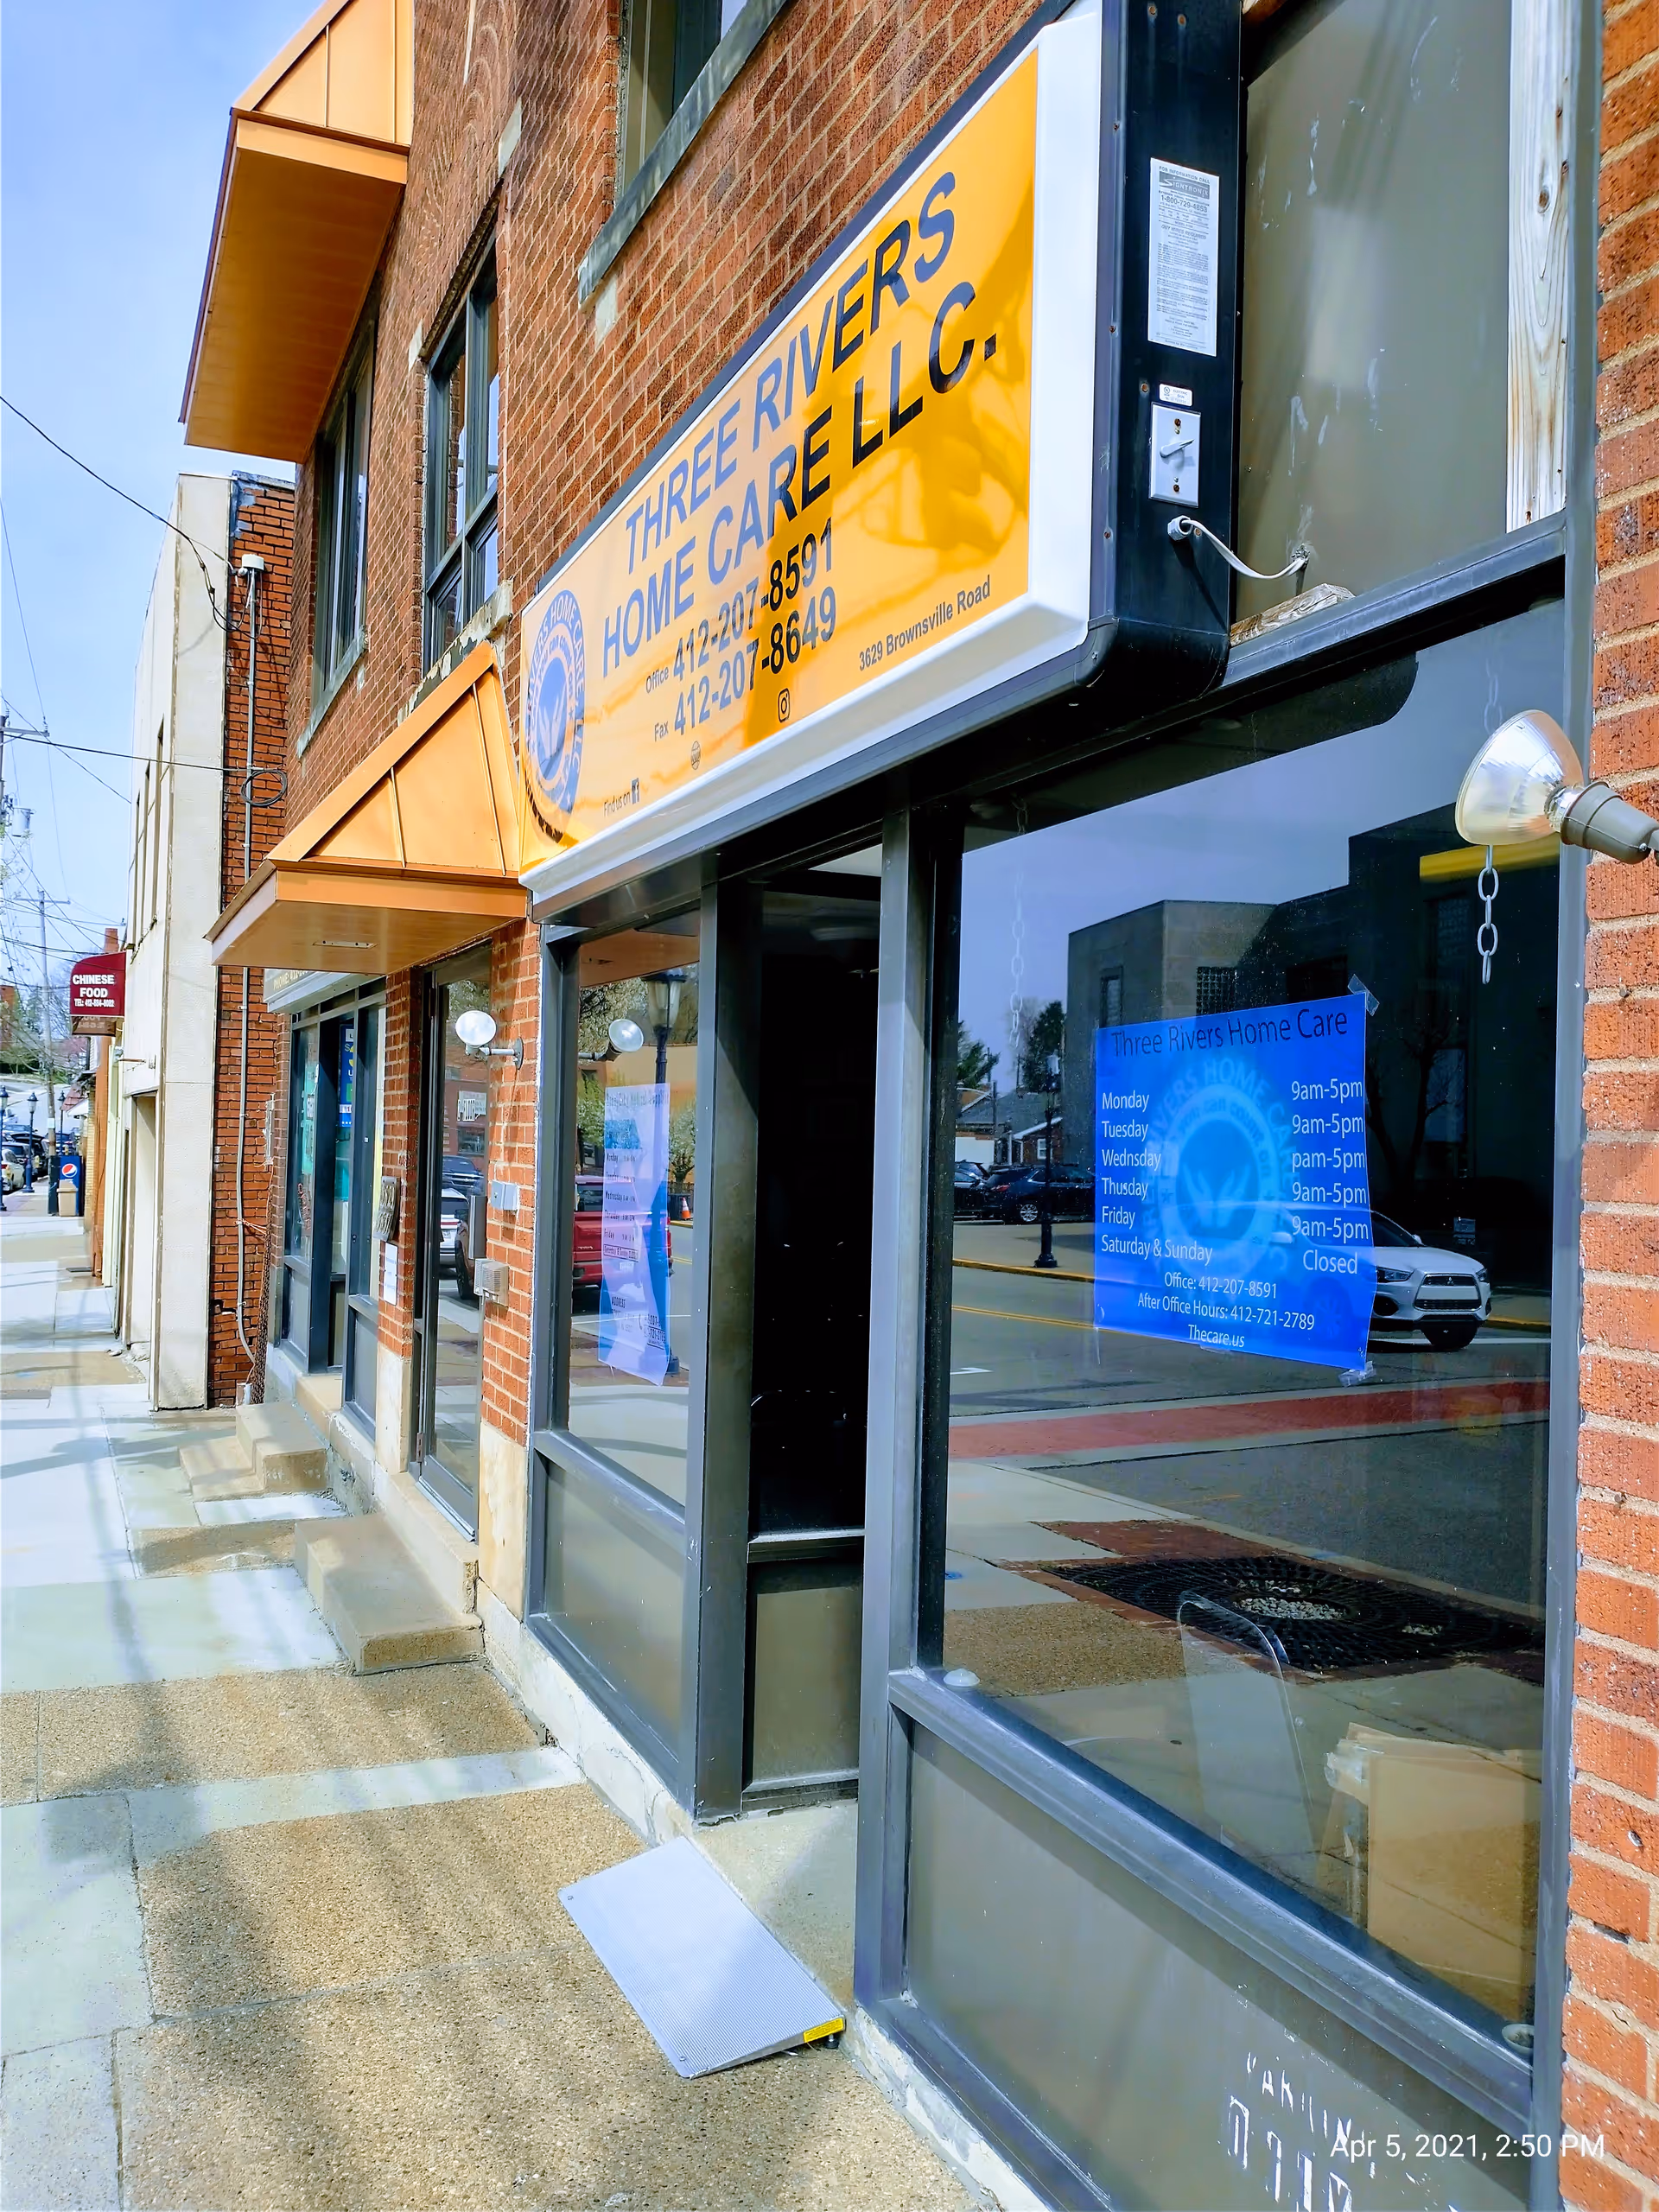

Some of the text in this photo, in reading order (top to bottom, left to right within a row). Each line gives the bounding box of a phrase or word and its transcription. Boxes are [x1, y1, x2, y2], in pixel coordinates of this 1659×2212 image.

[626, 171, 956, 575] THREE RIVERS
[603, 535, 696, 678] HOME
[709, 405, 832, 586] CARE
[852, 281, 996, 470] LLC.
[550, 594, 577, 630] HOME
[645, 517, 834, 694] Office 412-207-8591
[859, 574, 990, 671] 3629 Brownsville Road
[654, 586, 836, 742] Fax 412-207-8649
[73, 975, 115, 985] CHINESE
[79, 987, 108, 998] FOOD
[1111, 1008, 1348, 1057] Three Rivers Home Care
[1102, 1078, 1363, 1112] Monday 9am-5pm
[1102, 1113, 1363, 1141] Tuesday 9am-5pm
[1102, 1147, 1365, 1173] Wednsday pam-5pm
[1102, 1177, 1367, 1208] Thusday 9am-5pm
[1102, 1205, 1369, 1243] Friday 9am-5pm
[1102, 1234, 1357, 1274] Saturday & Sunday Closed
[1165, 1271, 1277, 1299] Office: 412-207-8591
[1138, 1293, 1315, 1331] After Office Hours: 412-721-2789
[1188, 1324, 1245, 1348] Thecare.us
